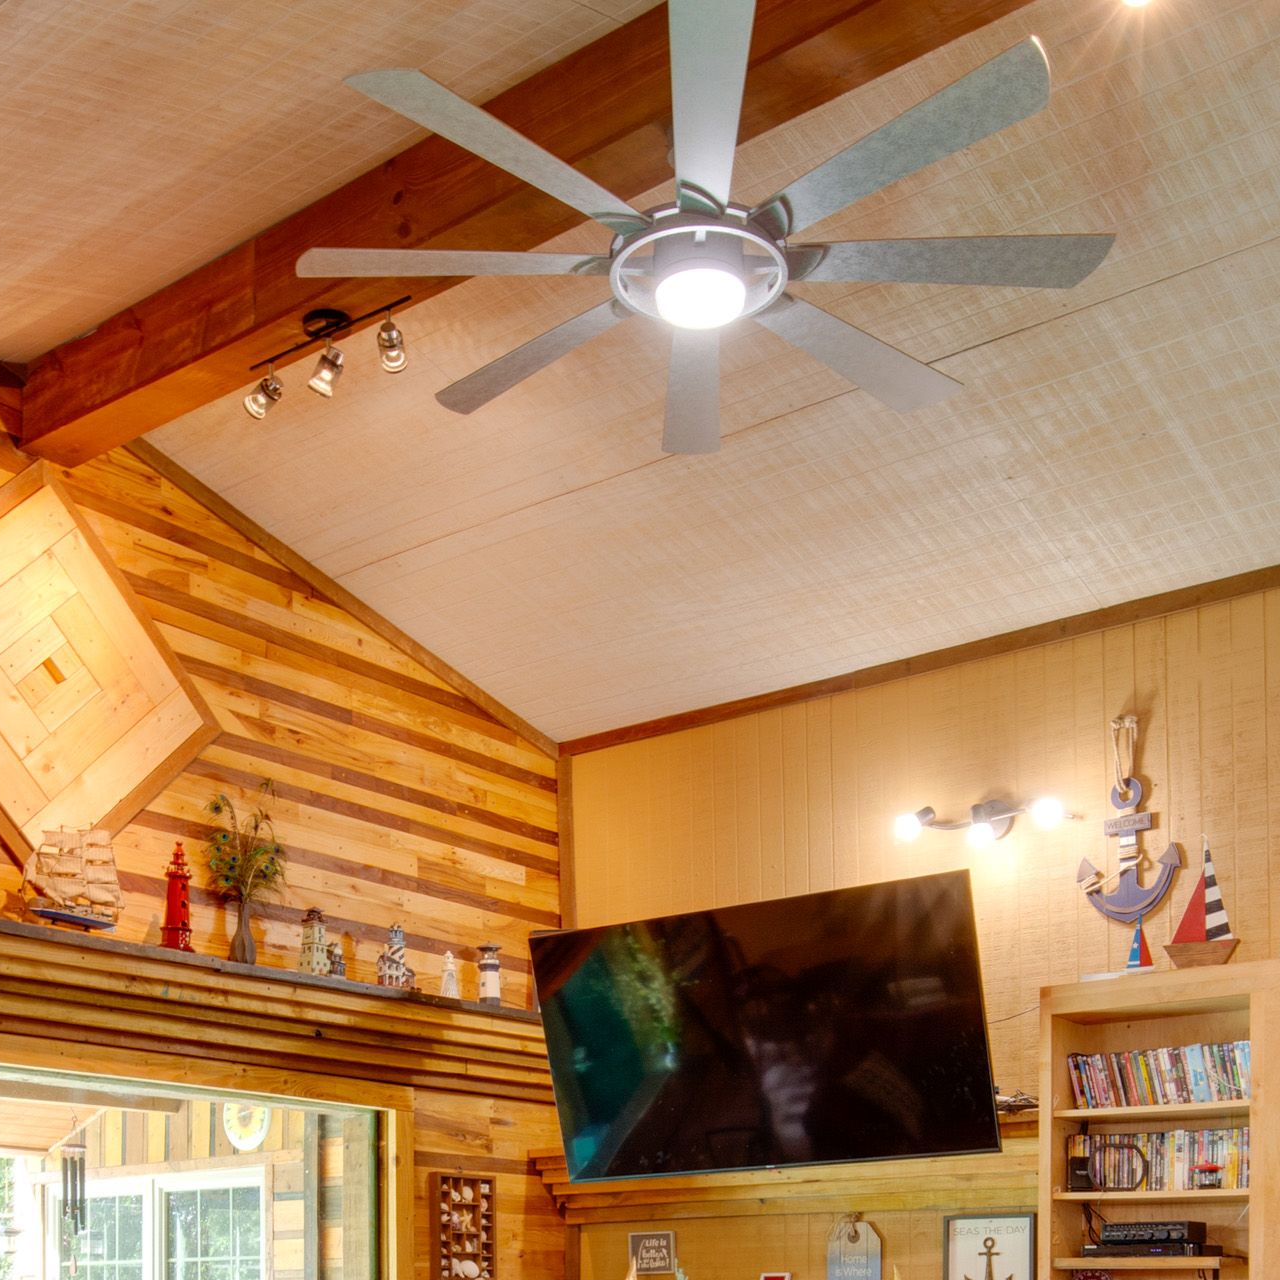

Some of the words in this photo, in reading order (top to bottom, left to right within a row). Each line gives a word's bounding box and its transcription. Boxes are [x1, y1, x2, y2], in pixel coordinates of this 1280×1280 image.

[952, 1226, 979, 1237] SEAS
[983, 1226, 1002, 1236] THE
[1006, 1225, 1027, 1235] DAY
[643, 1238, 659, 1247] Life
[840, 1255, 868, 1265] Home
[843, 1267, 872, 1277] Where
